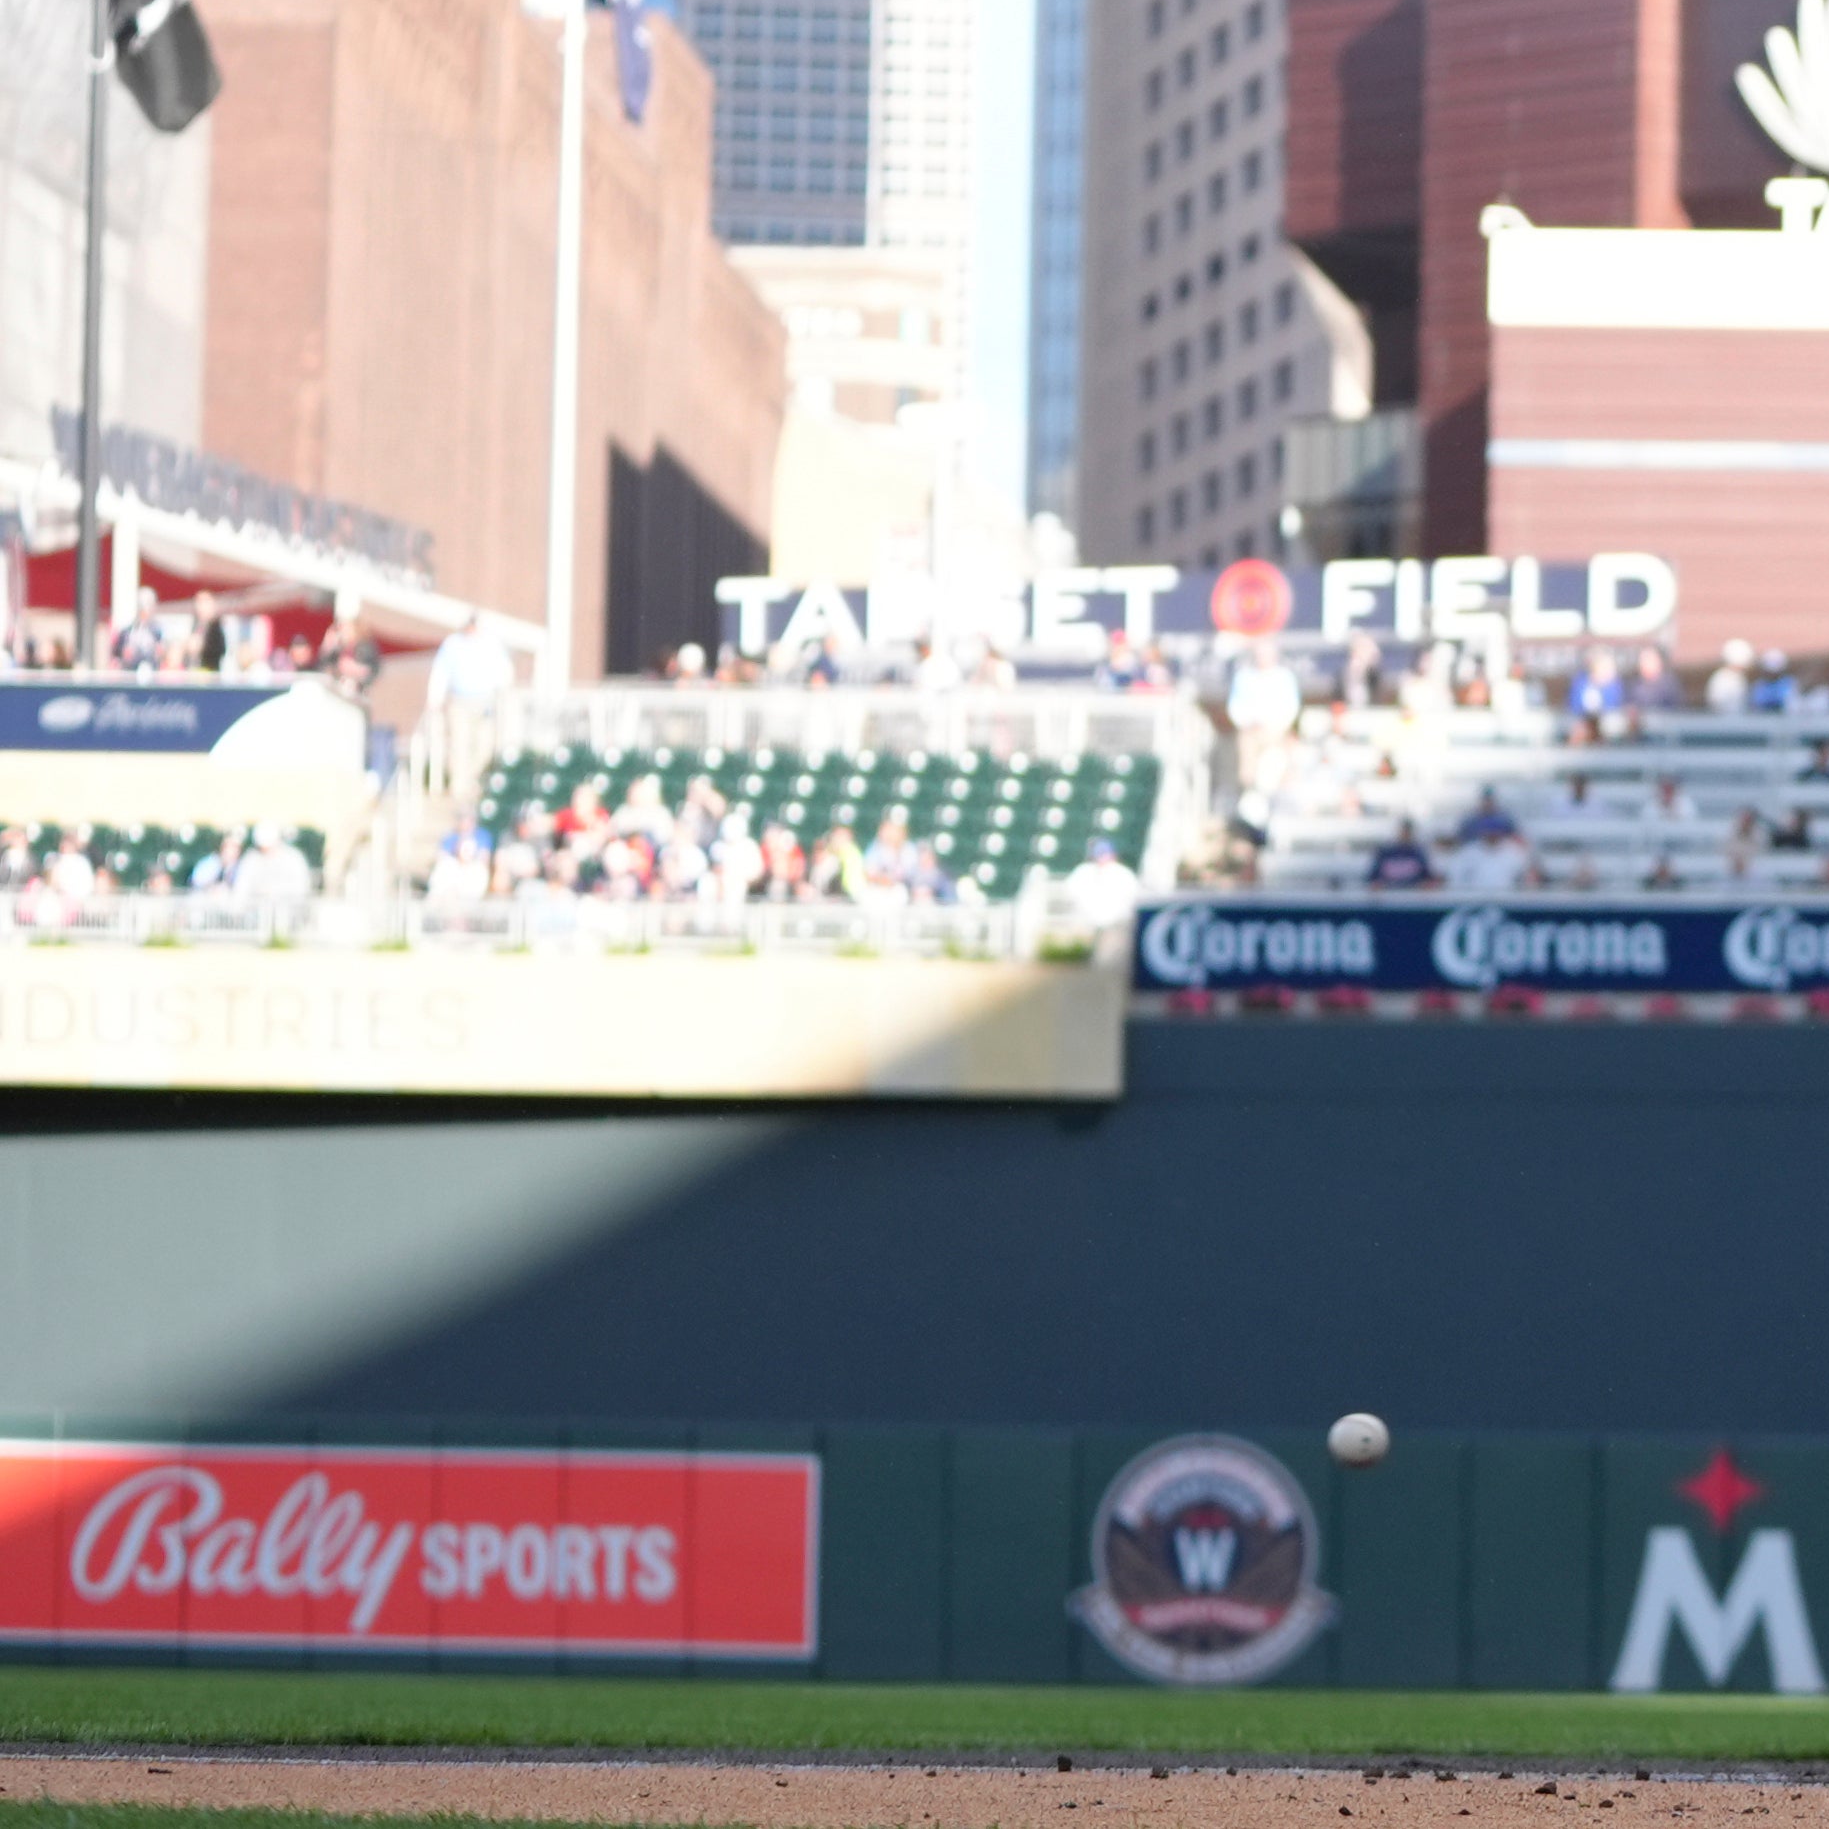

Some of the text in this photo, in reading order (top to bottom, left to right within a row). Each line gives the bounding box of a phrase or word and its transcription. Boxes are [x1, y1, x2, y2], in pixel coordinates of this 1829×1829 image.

[1321, 552, 1678, 641] FIELD
[1140, 903, 1374, 987] Corona
[1431, 903, 1665, 990] Corona
[0, 979, 470, 1052] DUSTRIES
[70, 1464, 679, 1636] Bally SPORTS
[1172, 1524, 1239, 1595] W
[1608, 1525, 1828, 1694] M
